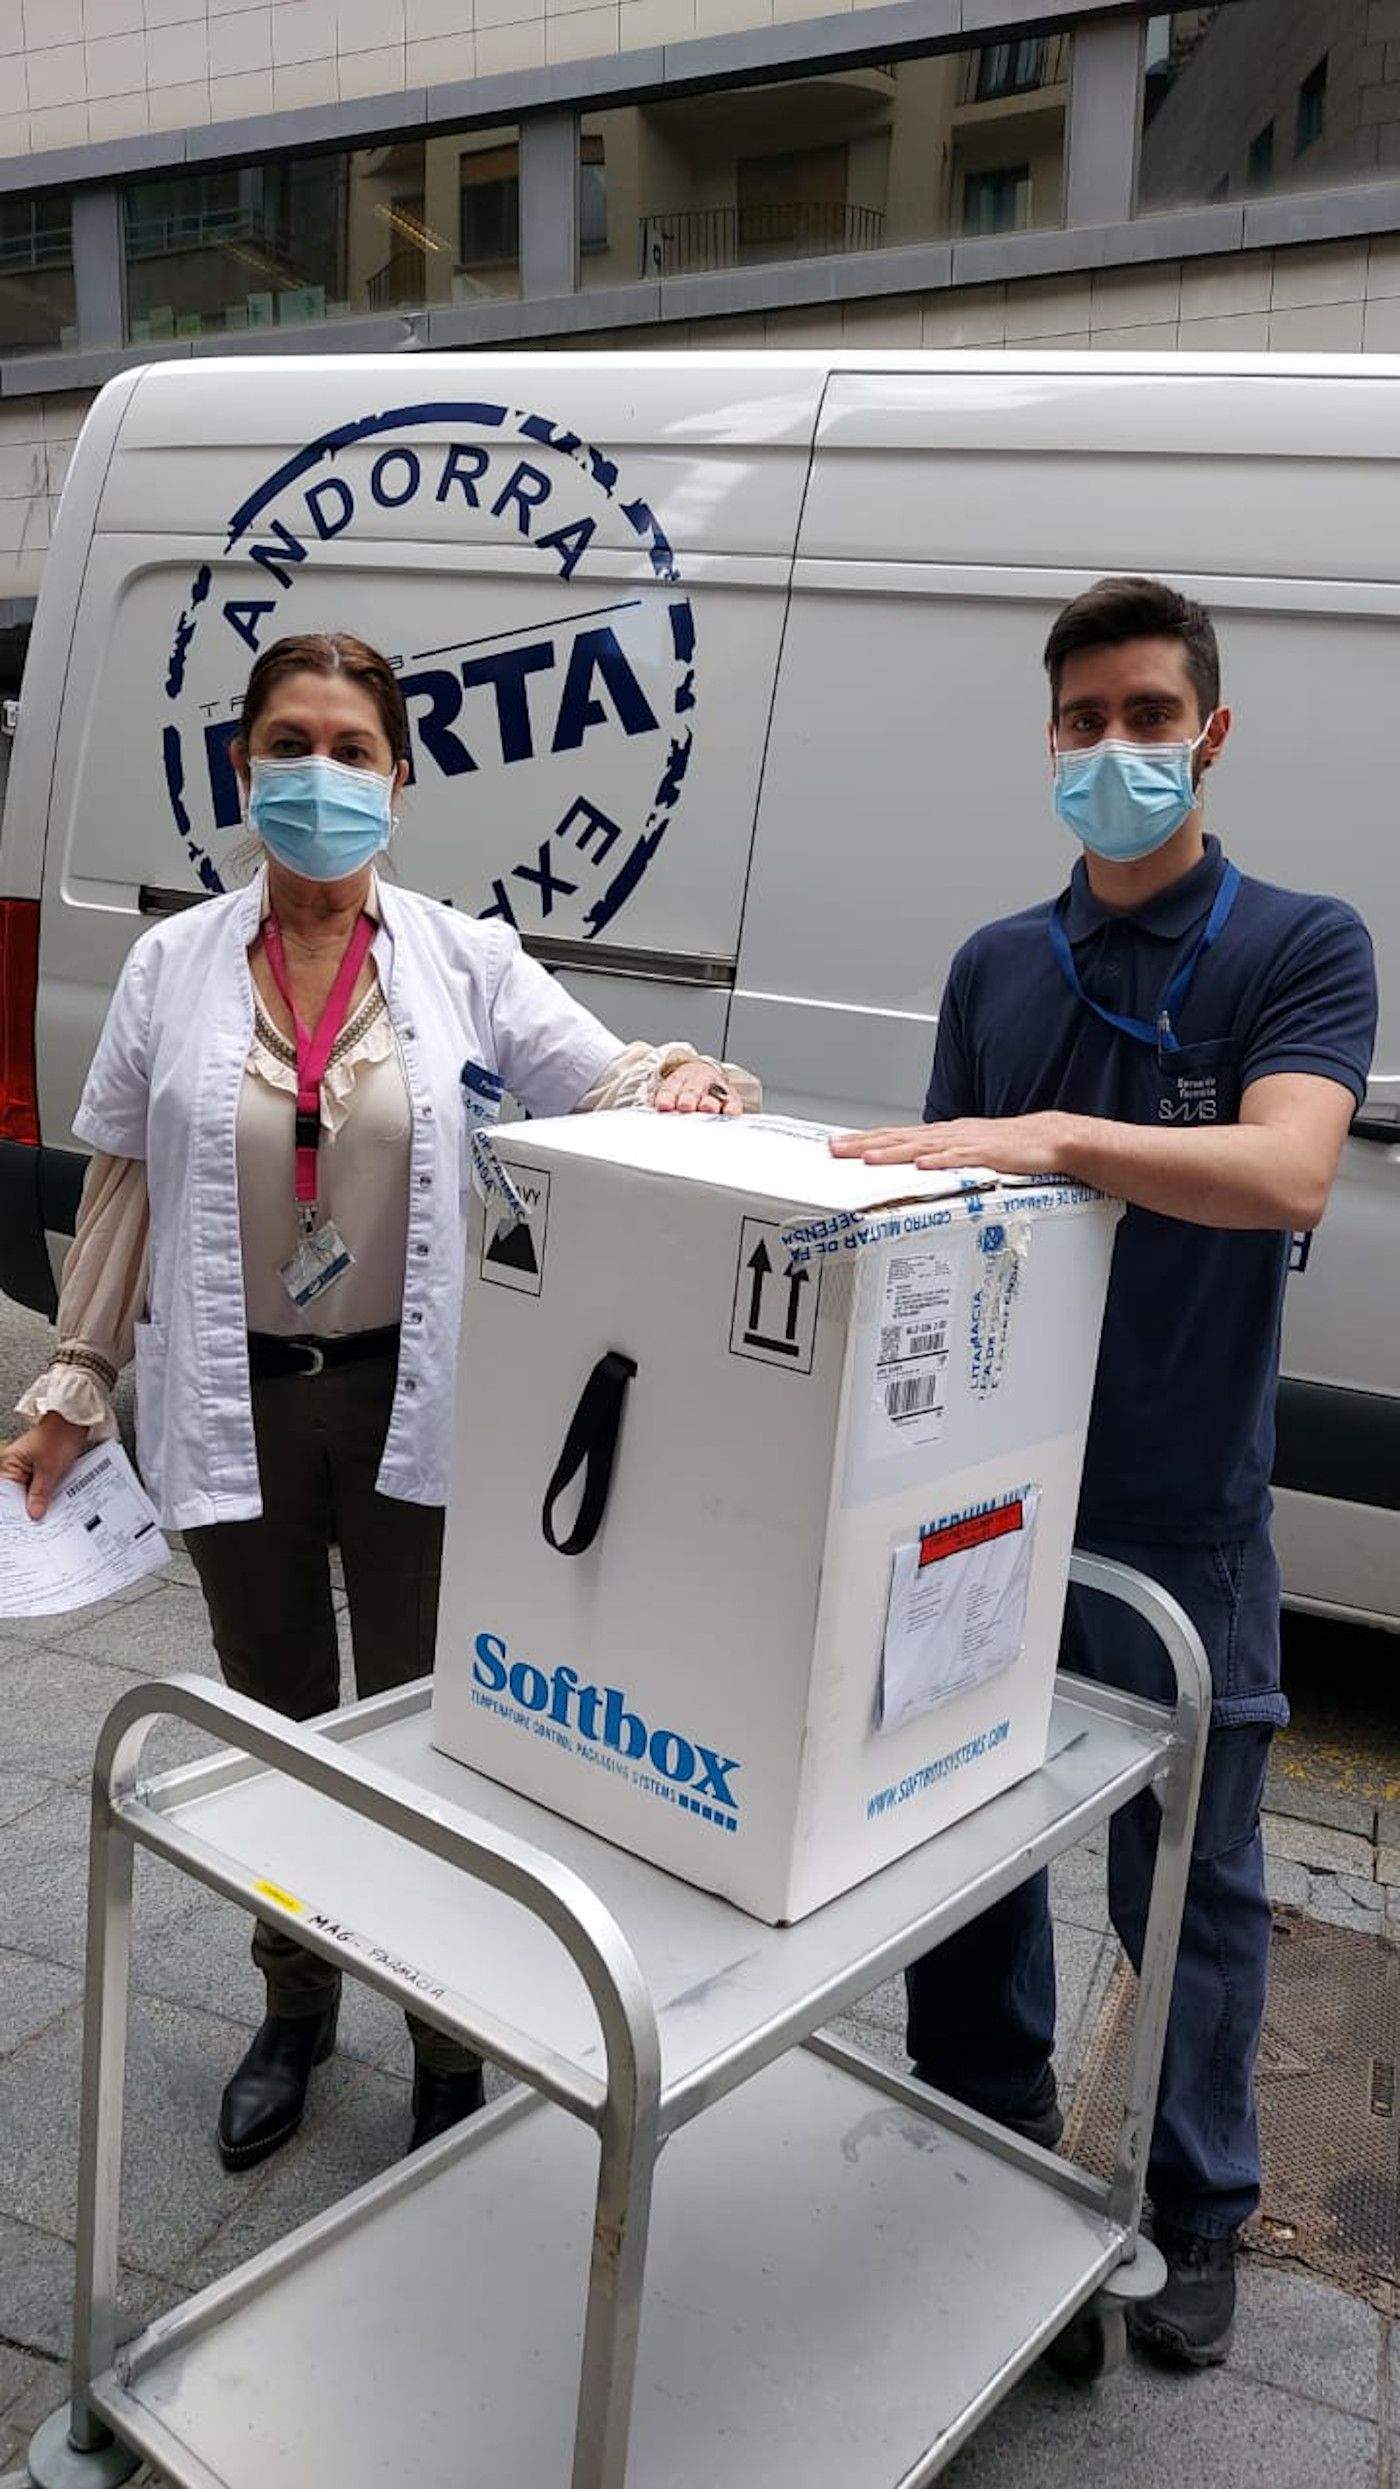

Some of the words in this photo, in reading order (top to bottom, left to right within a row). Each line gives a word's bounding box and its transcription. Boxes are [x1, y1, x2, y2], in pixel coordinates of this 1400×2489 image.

[222, 443, 597, 653] ANDORRA
[815, 1239, 839, 1254] DE
[845, 1220, 901, 1250] MILITAR
[904, 1211, 951, 1234] CENTRO
[471, 1689, 531, 1732] TEMPERATURE
[532, 1718, 572, 1752] CONTROL
[576, 1741, 630, 1779] PACKAGING
[631, 1769, 676, 1803] SYSTEMS
[473, 1633, 740, 1809] Softbox
